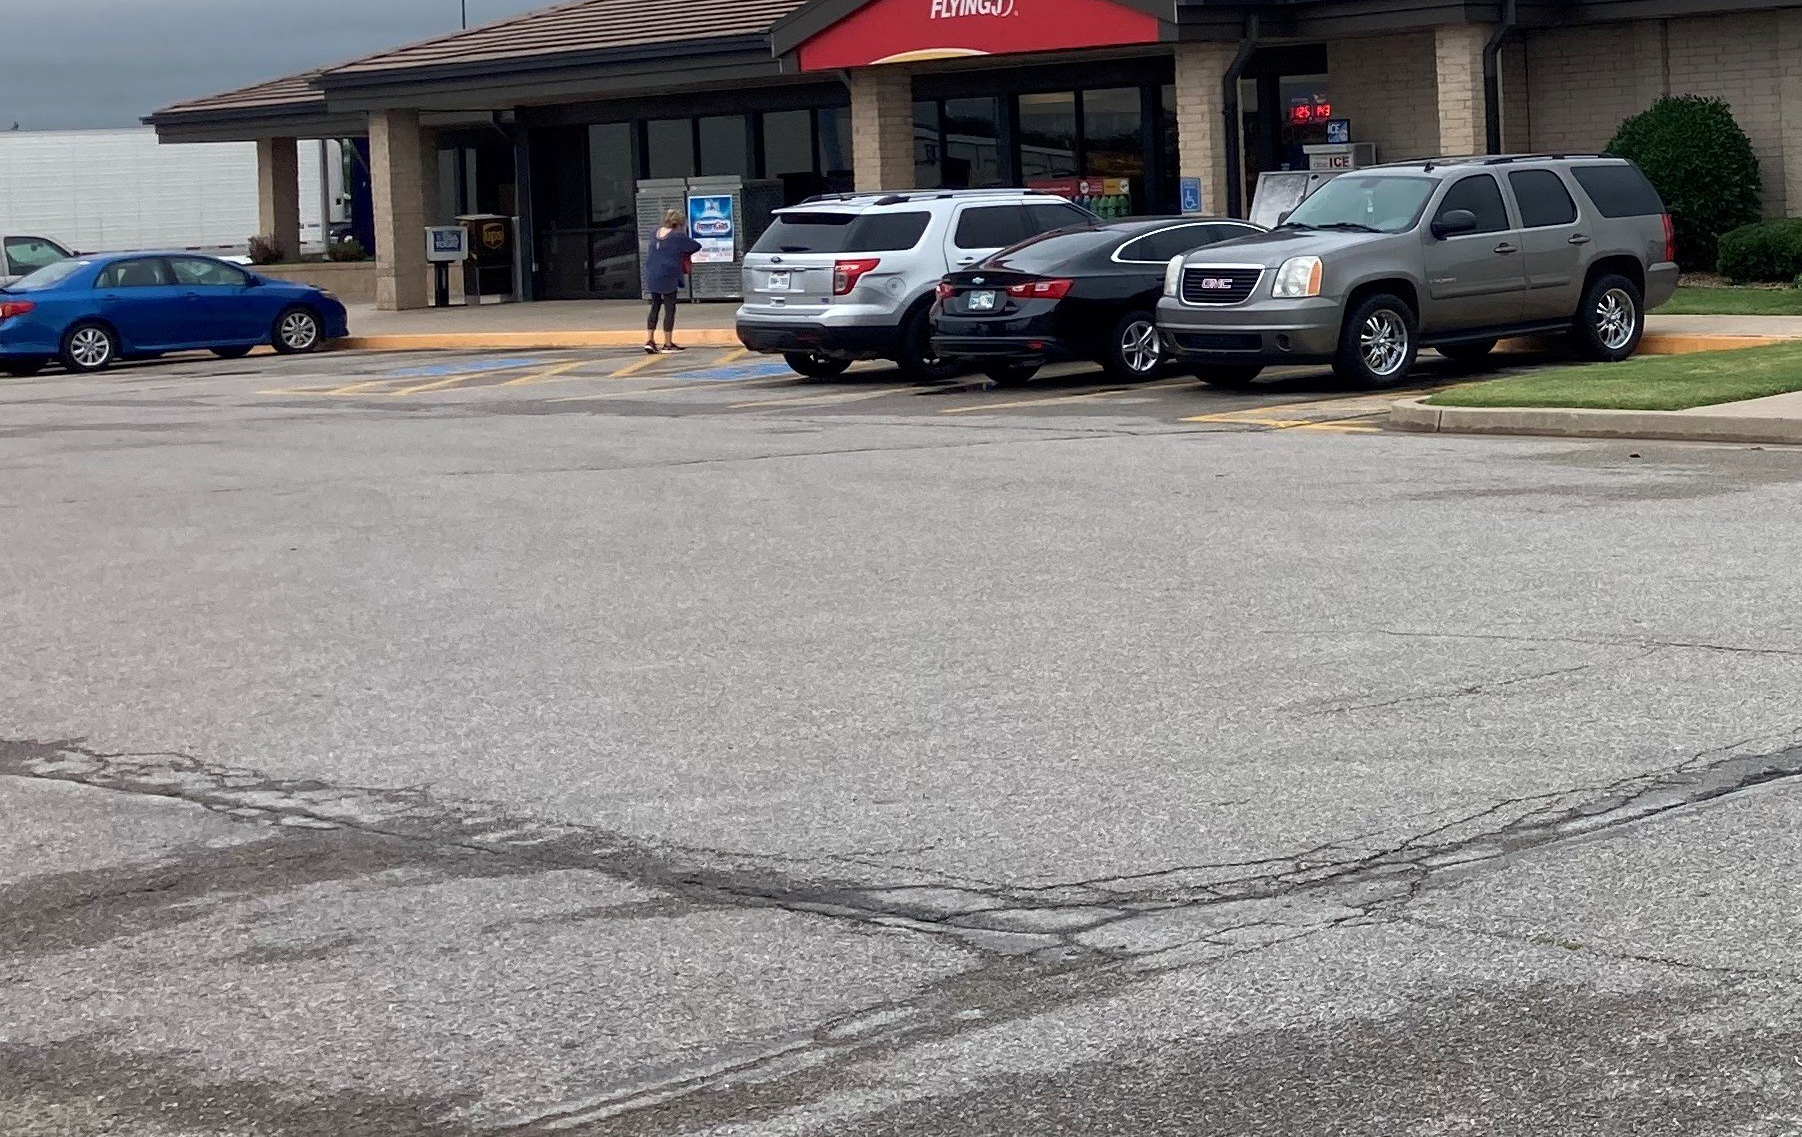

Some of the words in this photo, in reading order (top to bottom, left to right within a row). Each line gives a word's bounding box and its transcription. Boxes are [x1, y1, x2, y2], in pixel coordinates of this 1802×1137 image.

[1327, 123, 1340, 134] ICE
[1329, 156, 1350, 169] ICE
[1201, 278, 1233, 289] GMC
